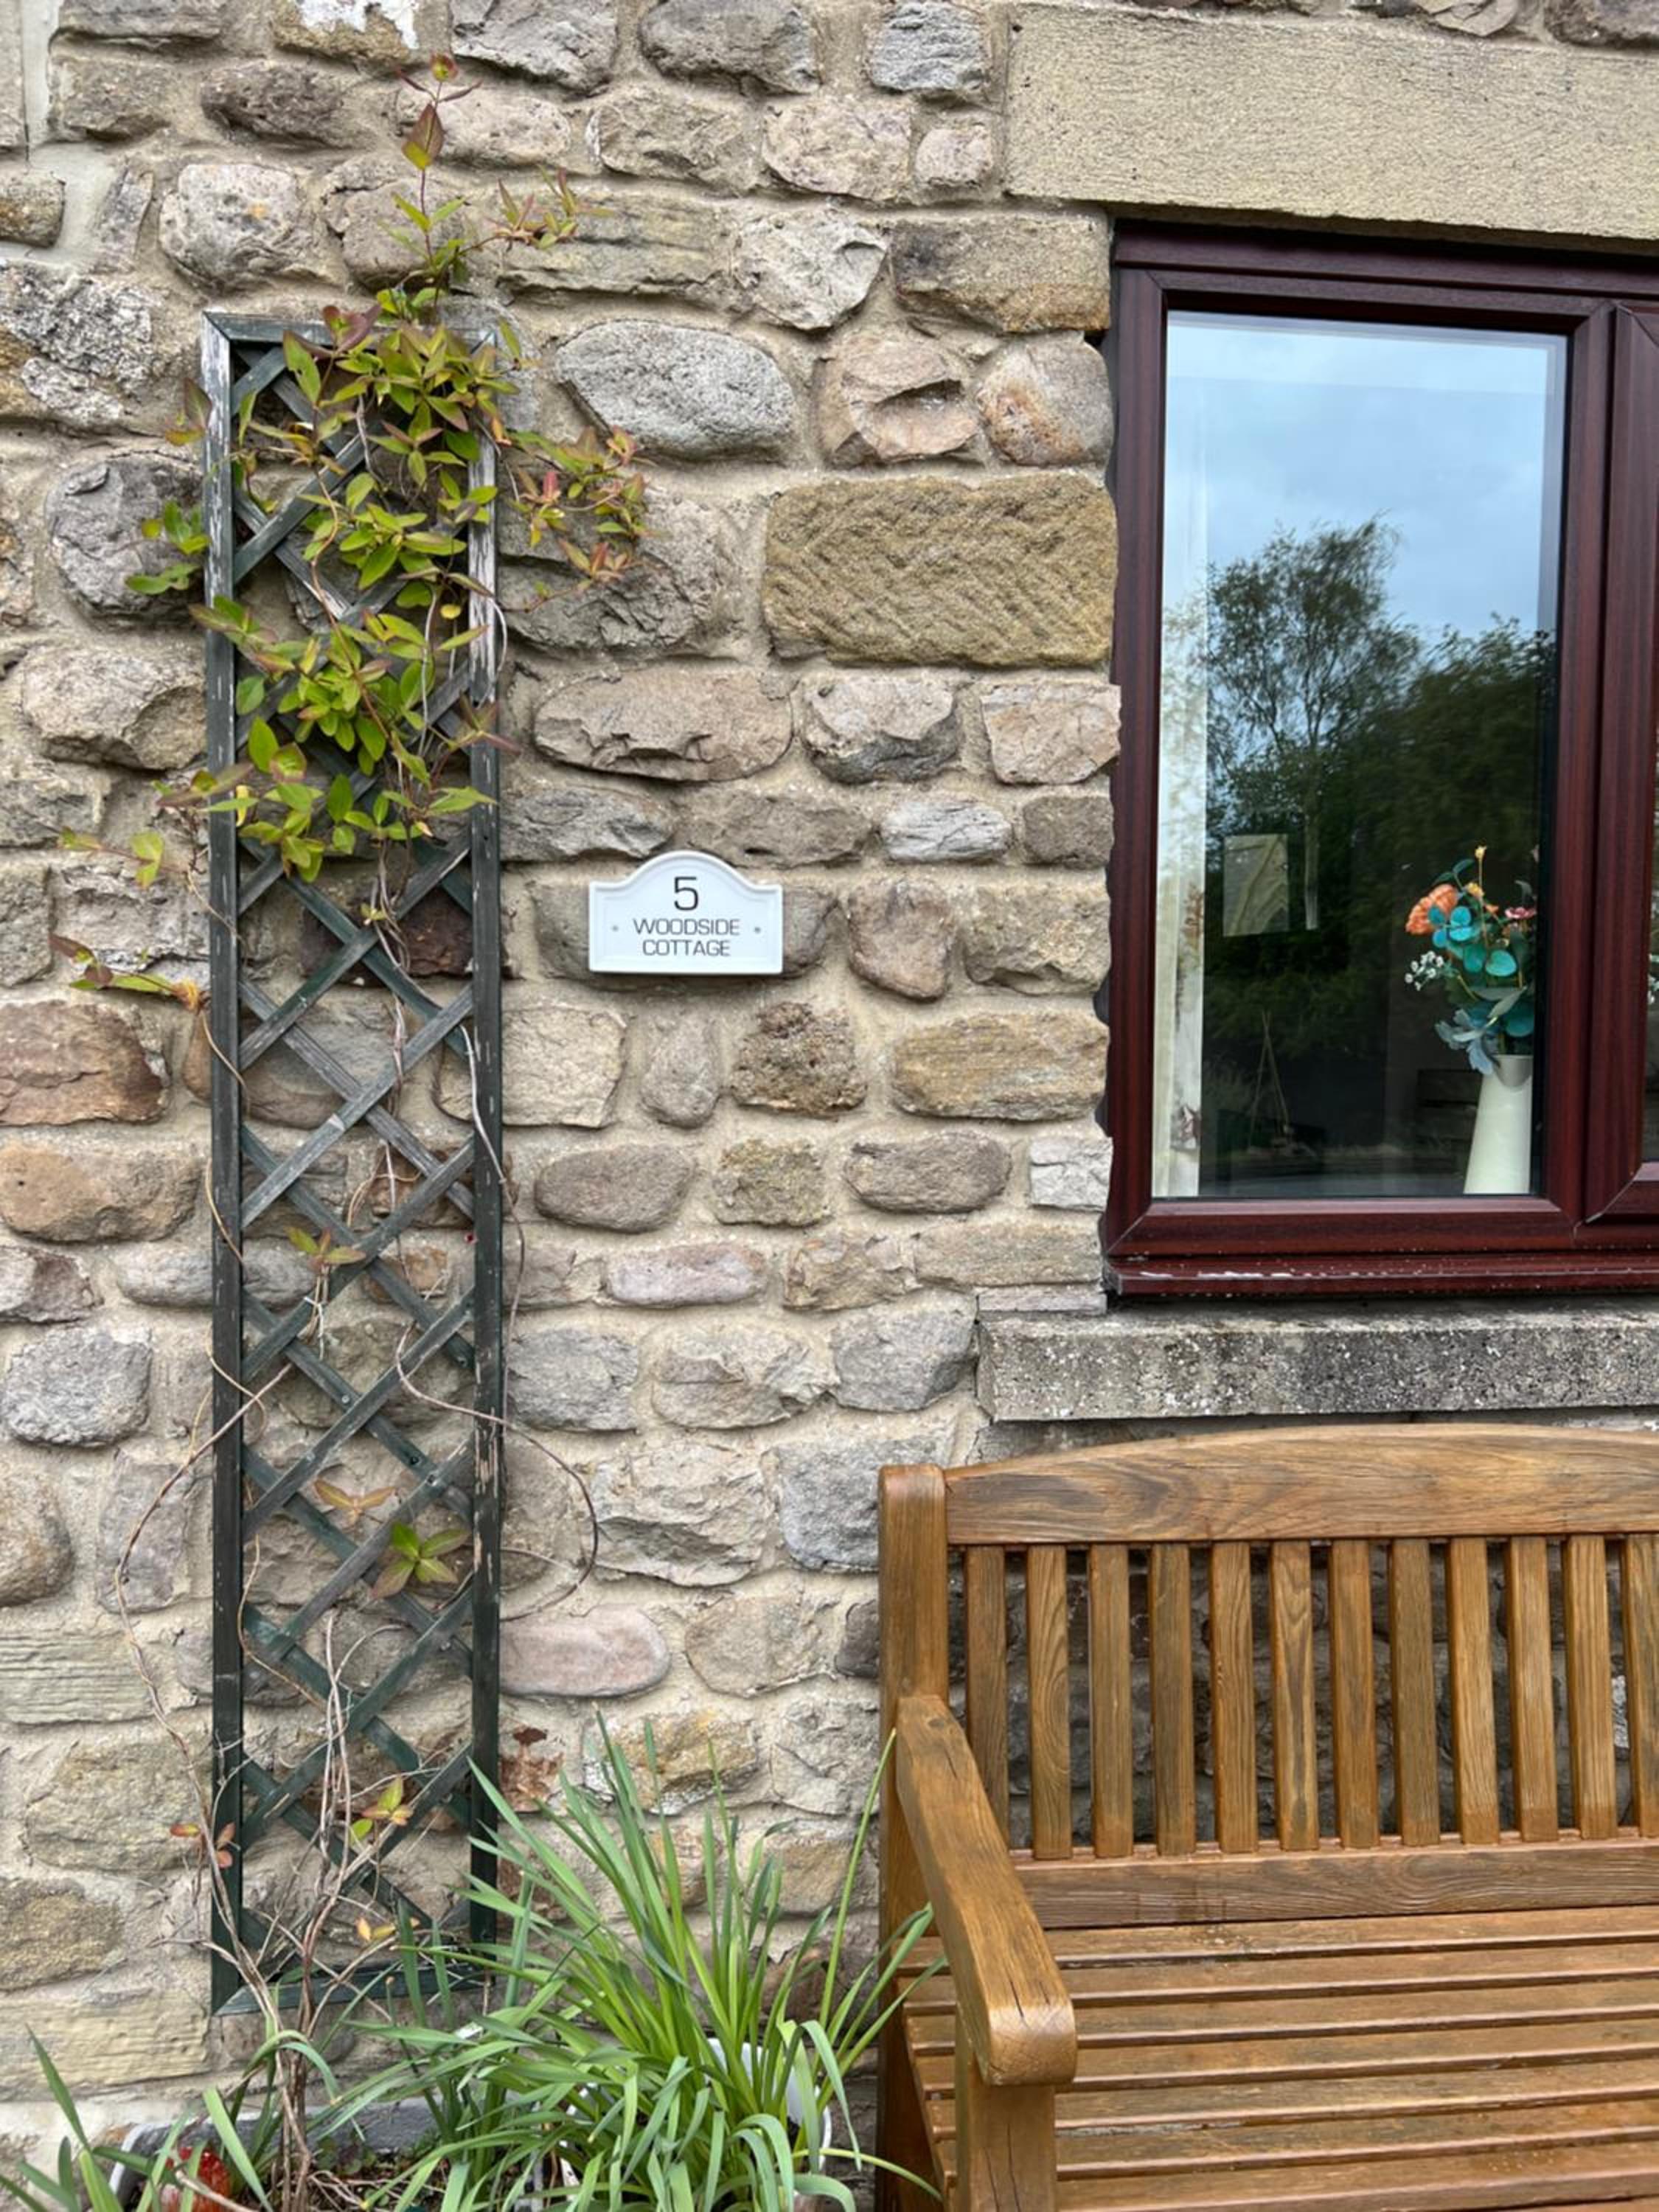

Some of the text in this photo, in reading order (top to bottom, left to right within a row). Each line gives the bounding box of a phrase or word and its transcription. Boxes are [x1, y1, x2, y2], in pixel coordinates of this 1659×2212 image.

[674, 876, 699, 911] 5
[633, 918, 741, 936] WOODSIDE
[642, 939, 731, 956] COTTAGE
